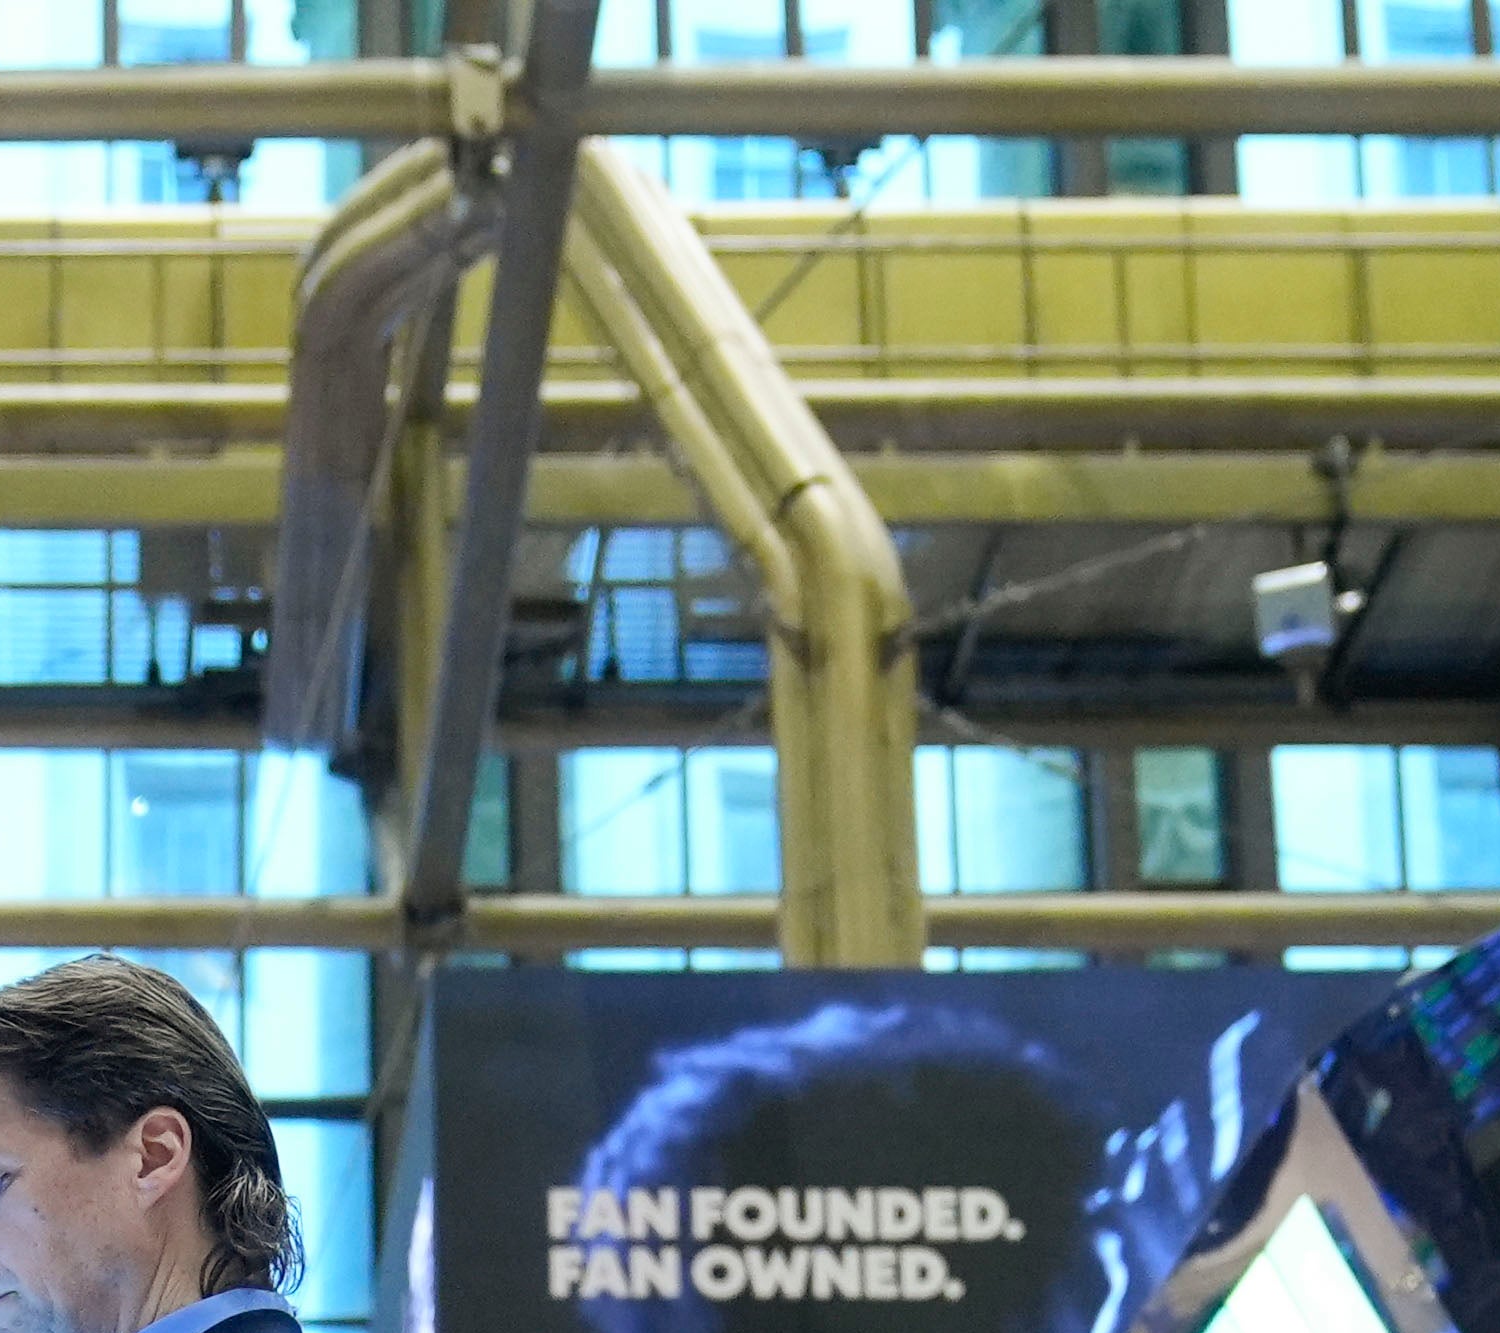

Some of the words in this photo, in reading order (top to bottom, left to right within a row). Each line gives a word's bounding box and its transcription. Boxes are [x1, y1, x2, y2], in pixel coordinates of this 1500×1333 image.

[547, 1185, 681, 1241] FAN
[690, 1185, 1025, 1241] FOUNDED.
[547, 1245, 681, 1301] FAN
[690, 1245, 966, 1302] OWNED.
